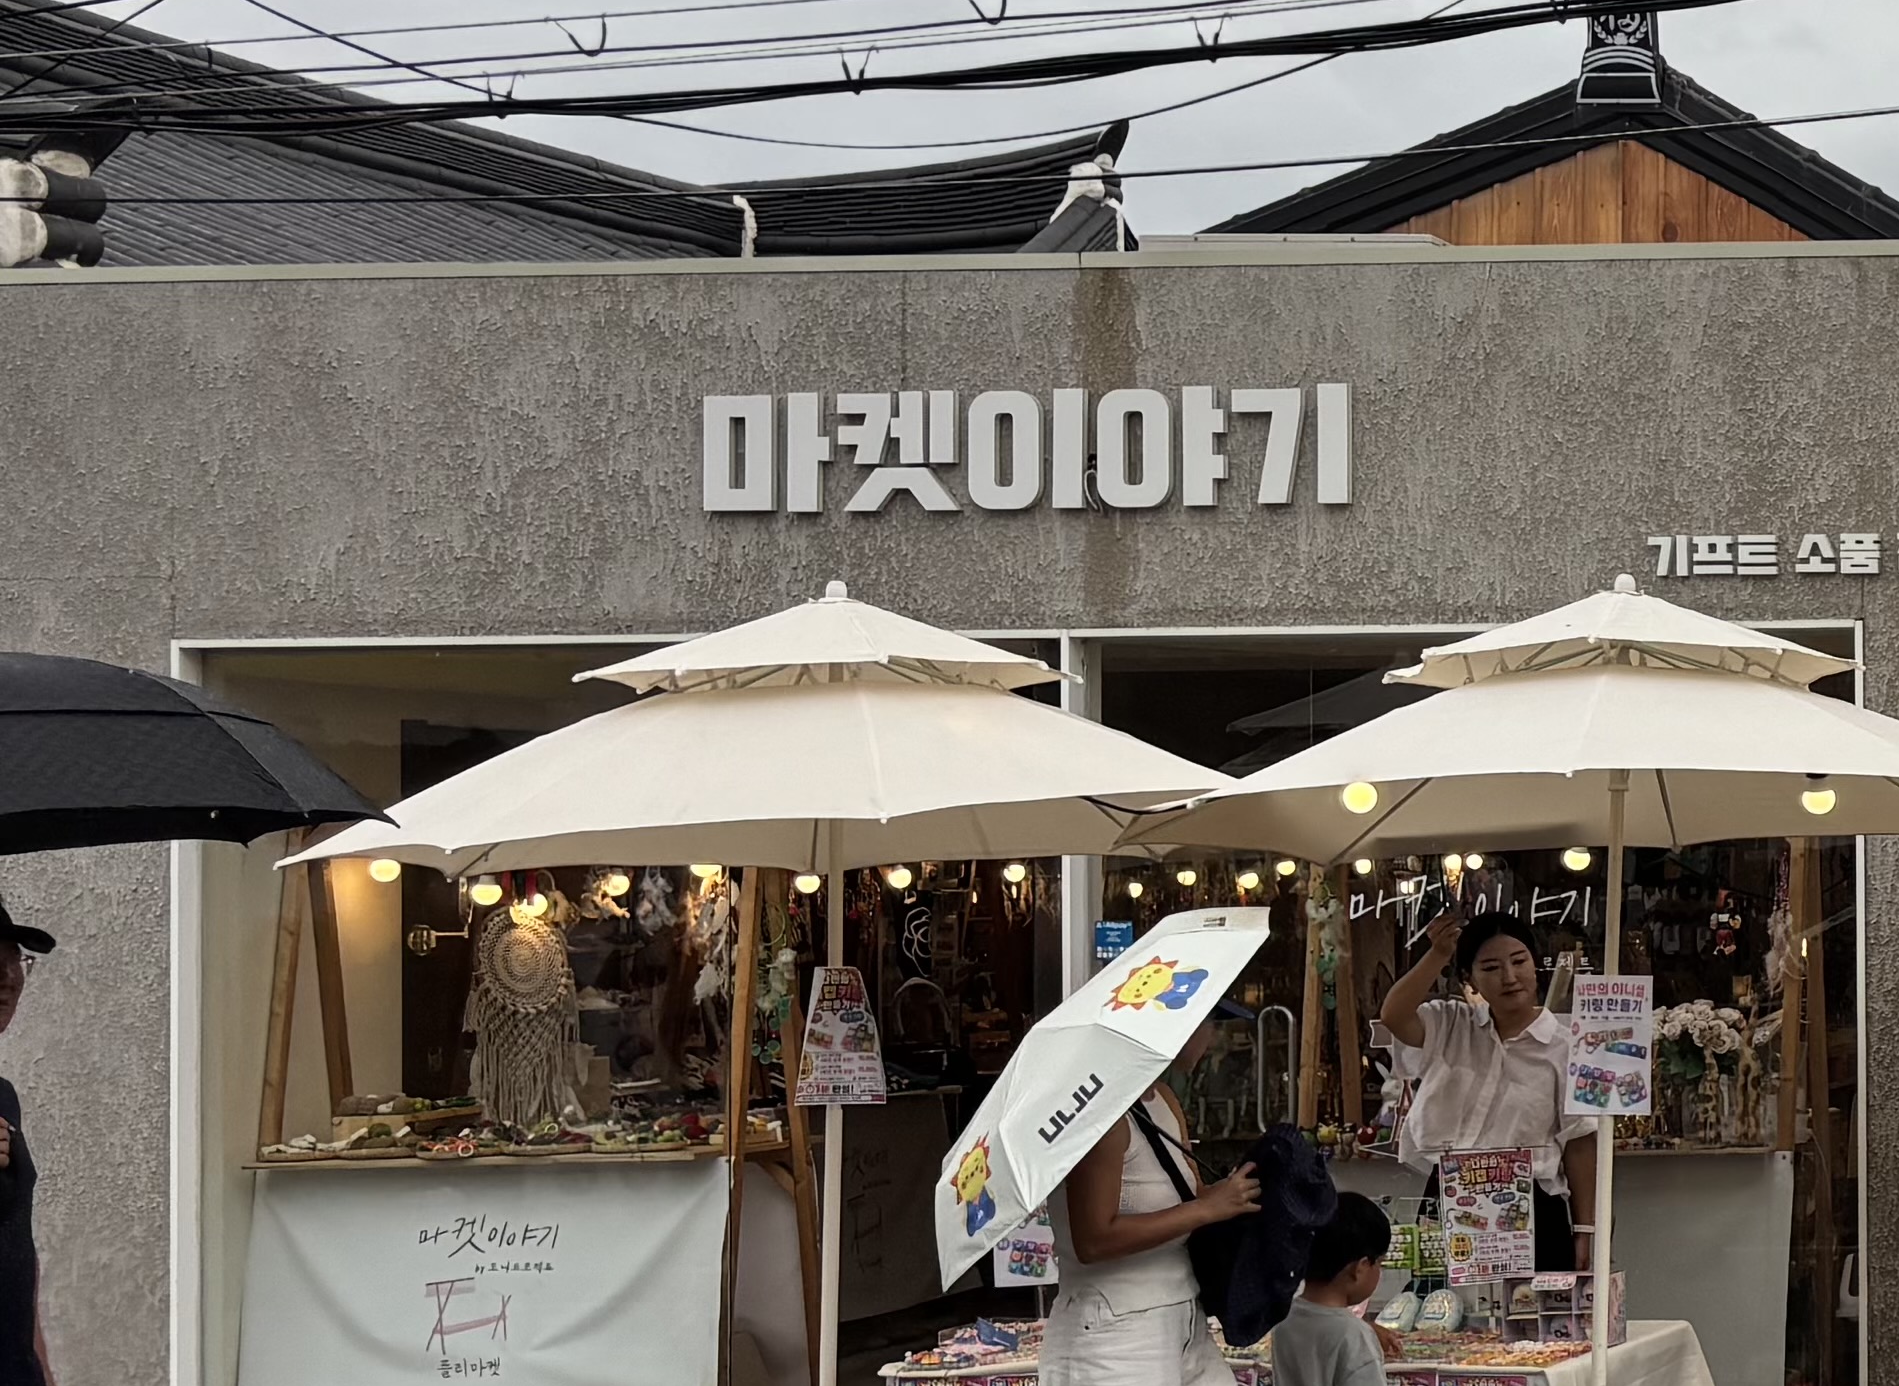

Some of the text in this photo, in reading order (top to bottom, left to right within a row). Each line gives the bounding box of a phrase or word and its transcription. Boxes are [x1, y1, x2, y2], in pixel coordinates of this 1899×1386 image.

[702, 381, 1353, 517] 마켓이야기
[1646, 534, 1779, 577] 기프트
[1795, 533, 1881, 575] 소품
[419, 1214, 560, 1258] 마켓이야기
